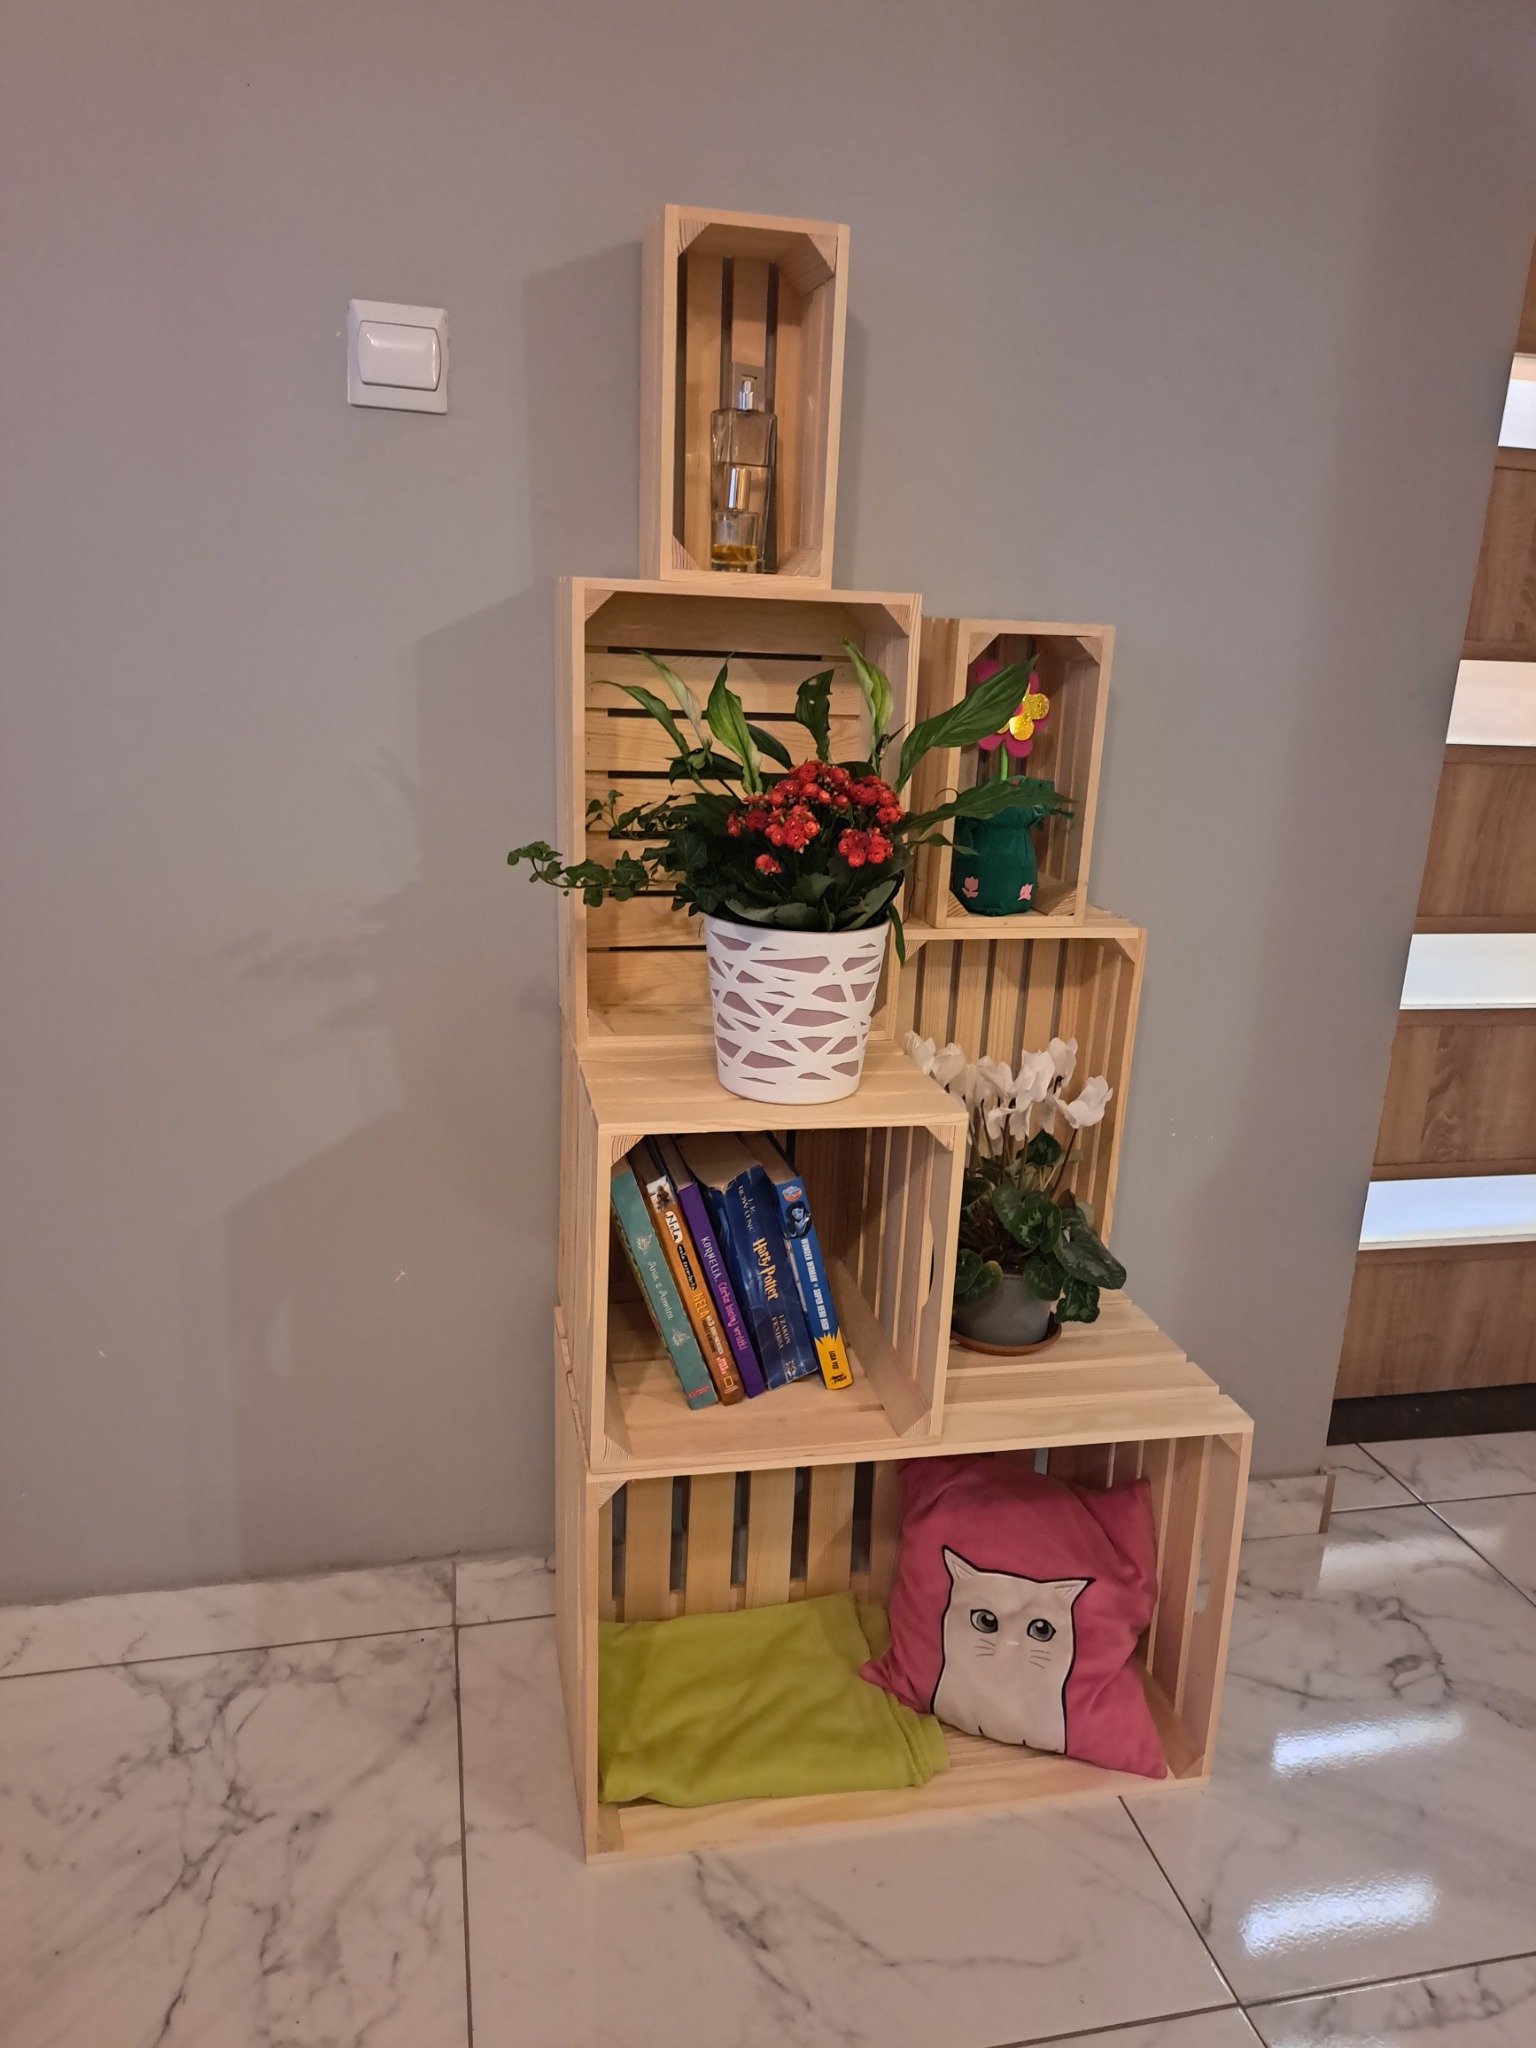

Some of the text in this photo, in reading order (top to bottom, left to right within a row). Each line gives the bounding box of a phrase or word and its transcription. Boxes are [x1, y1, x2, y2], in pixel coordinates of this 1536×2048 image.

[666, 1214, 680, 1241] Nela
[648, 1260, 660, 1281] Ania
[752, 1237, 779, 1301] Harry Potter
[692, 1292, 710, 1321] NELA
[813, 1288, 824, 1305] SUPER
